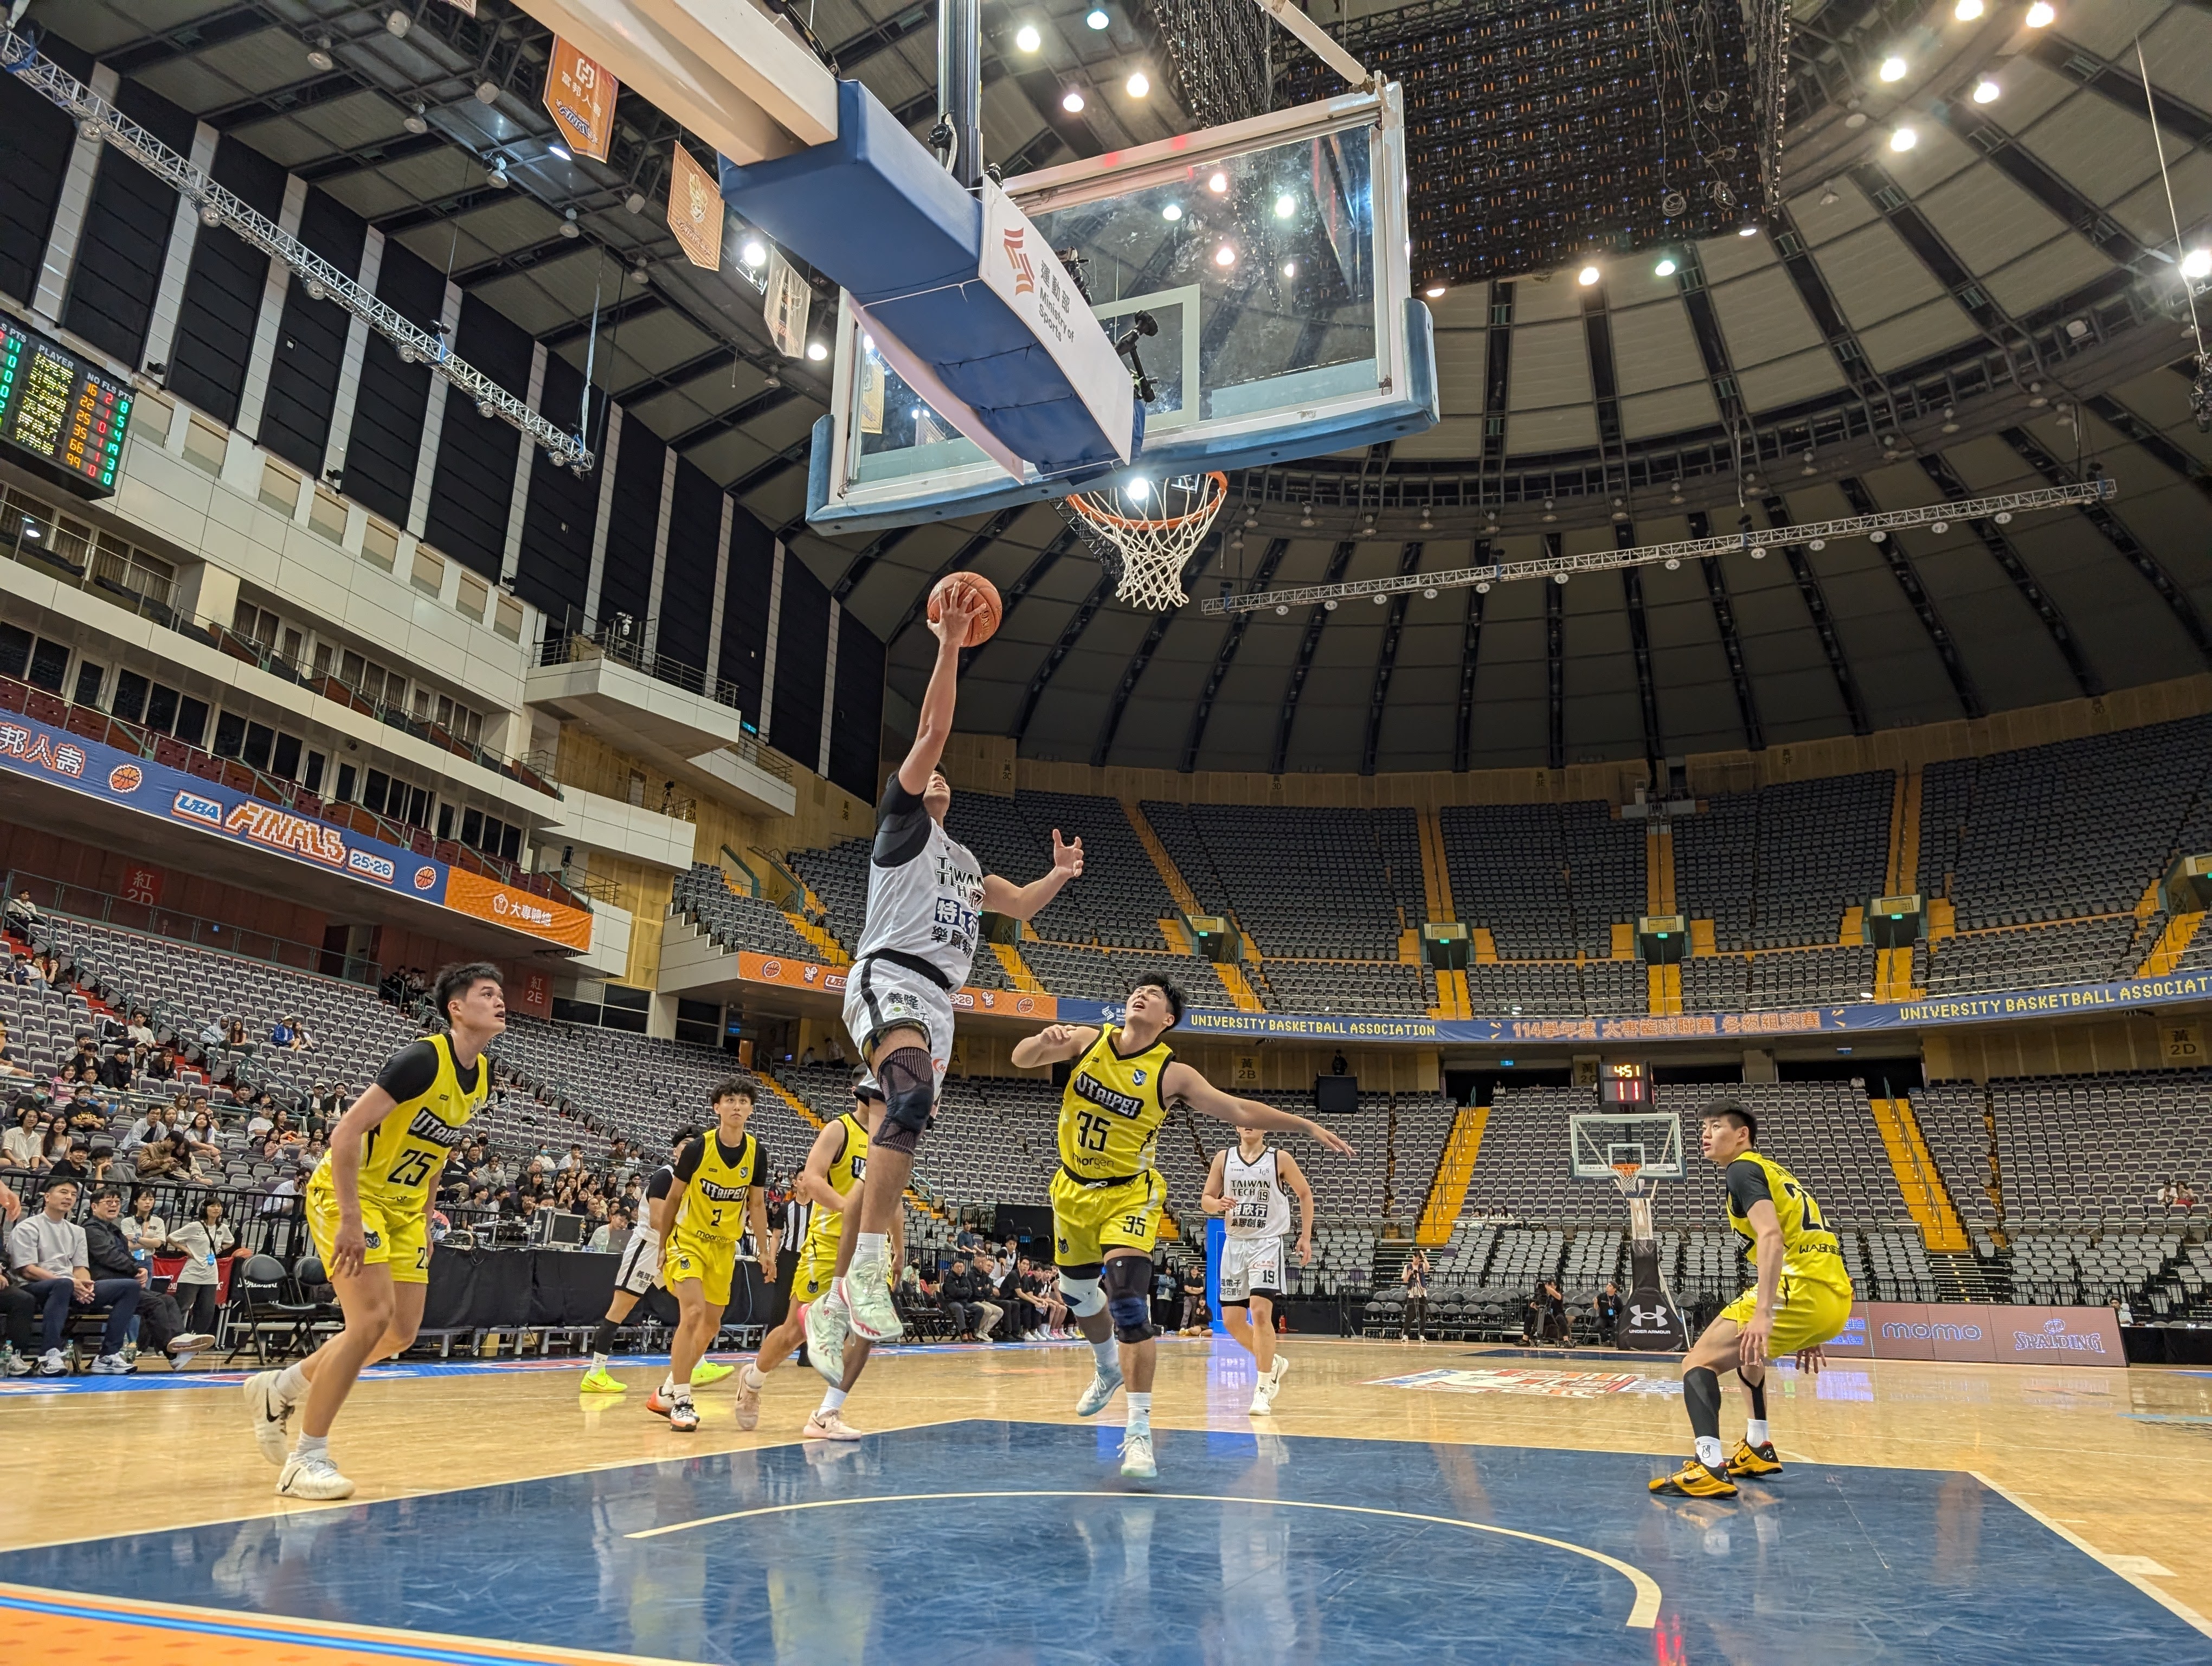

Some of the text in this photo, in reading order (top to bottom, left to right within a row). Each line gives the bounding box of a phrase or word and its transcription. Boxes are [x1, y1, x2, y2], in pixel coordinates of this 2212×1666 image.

[1041, 260, 1070, 313] 運動部
[1039, 304, 1062, 342] Sports
[1040, 287, 1074, 343] Ministry of
[10, 328, 27, 343] PTS
[8, 354, 17, 369] 0
[38, 344, 74, 370] PLAYER
[4, 370, 14, 383] 0
[87, 372, 133, 403] NO FLS PTS
[87, 383, 98, 397] 16
[80, 395, 95, 411] 22
[73, 424, 87, 440] 35
[76, 409, 122, 441] 25 0 4
[69, 438, 84, 454] 66
[66, 452, 113, 485] 99 0 0
[0, 726, 81, 774] 邦人壽
[178, 795, 391, 875] UBA FINALS 25-26
[133, 870, 155, 889] 紅
[126, 888, 155, 906] 2D
[531, 976, 543, 990] 紅
[527, 990, 543, 1004] 2E
[949, 995, 972, 1004] 5-26
[1900, 1000, 2001, 1020] UNIVERSITY
[2006, 990, 2114, 1012] BASKETBALL
[1191, 1014, 1435, 1036] UNIVERSITY BASKETBALL ASSOCIATION
[1512, 1011, 1821, 1038] 114學年度 大專籃球聯賽 各級組決賽
[2170, 1043, 2196, 1055] 2D
[1238, 1070, 1256, 1079] 2B
[1614, 1065, 1640, 1078] 4:51
[1076, 1072, 1140, 1117] UTAIPEI
[1619, 1081, 1639, 1100] 11
[1077, 1110, 1111, 1152] 35
[387, 1149, 439, 1187] 25
[702, 1180, 747, 1200] UTAIPEI
[1231, 1180, 1271, 1189] TAIWAN
[1231, 1188, 1269, 1201] TECH 19
[711, 1209, 722, 1227] 2
[1233, 1203, 1267, 1216] 特欣行
[1123, 1215, 1147, 1238] 35
[1262, 1270, 1275, 1284] 19
[1882, 1322, 1983, 1341] momo
[2013, 1331, 2105, 1354] SPALDING
